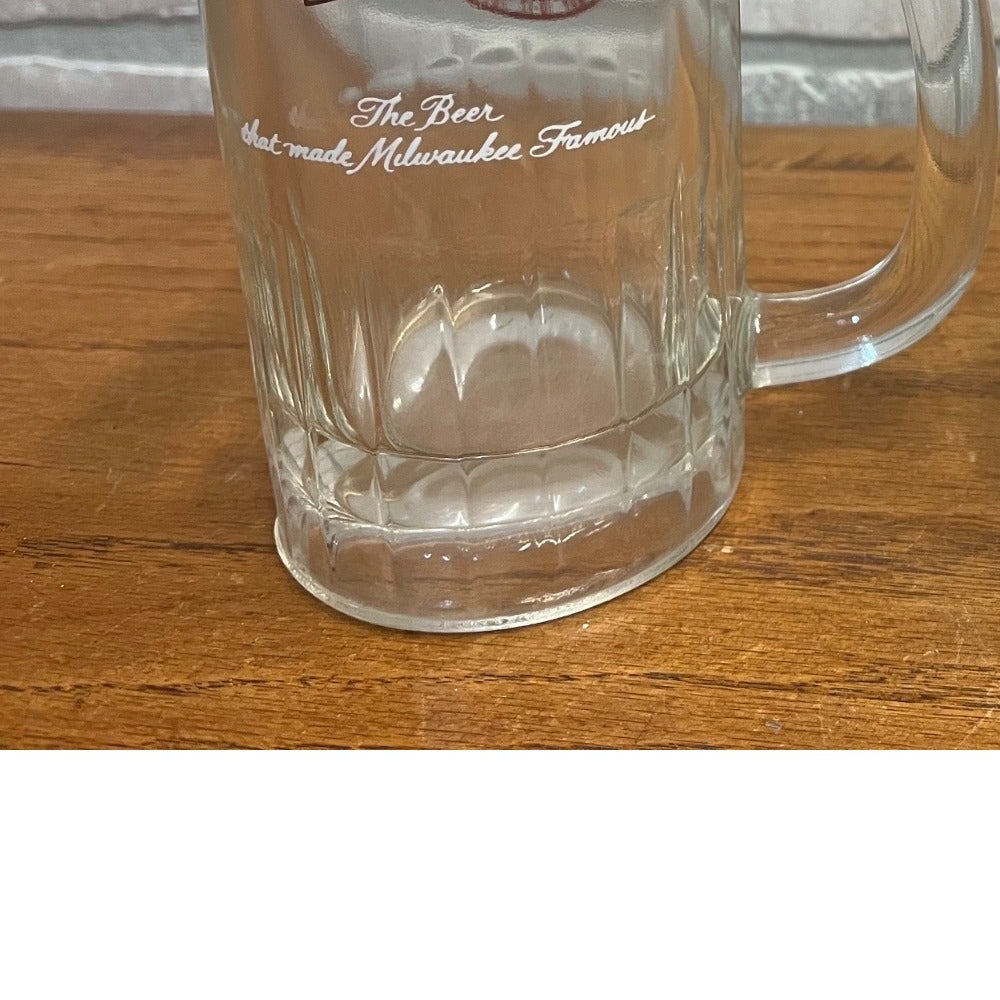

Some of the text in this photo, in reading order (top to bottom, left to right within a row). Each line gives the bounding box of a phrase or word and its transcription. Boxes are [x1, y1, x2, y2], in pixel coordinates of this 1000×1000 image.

[350, 92, 504, 131] The Beer
[241, 108, 656, 175] that made Milwaukee Famous
